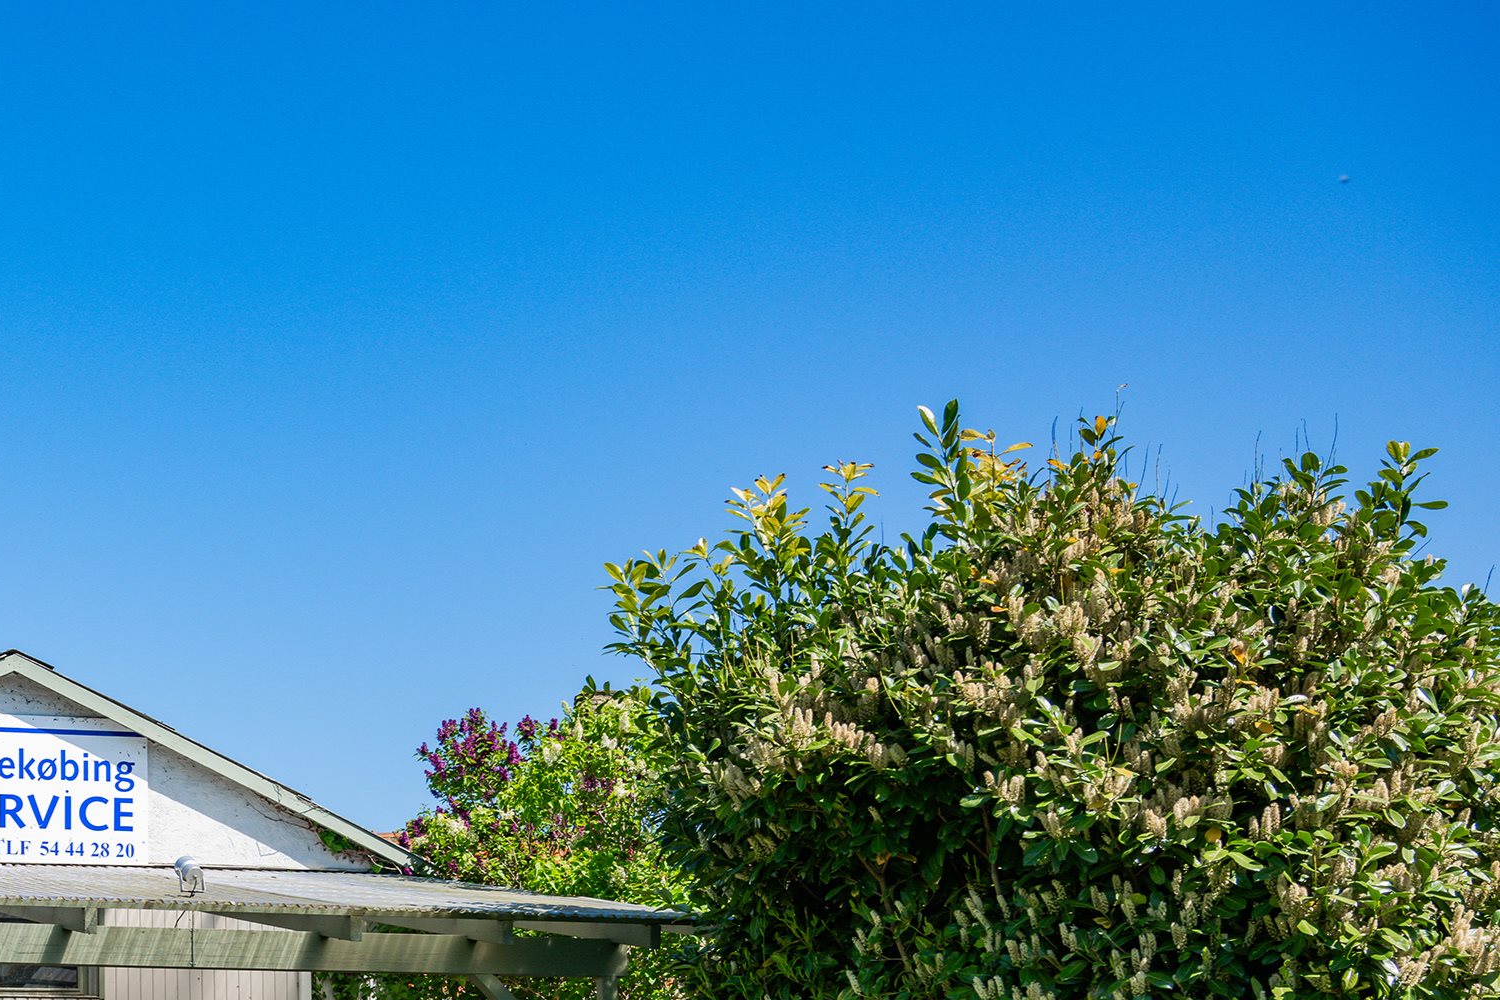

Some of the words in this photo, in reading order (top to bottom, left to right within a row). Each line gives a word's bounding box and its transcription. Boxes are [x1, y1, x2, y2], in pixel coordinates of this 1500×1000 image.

[39, 841, 60, 856] 54
[64, 842, 85, 857] 44
[90, 842, 110, 858] 28
[115, 843, 135, 858] 20
